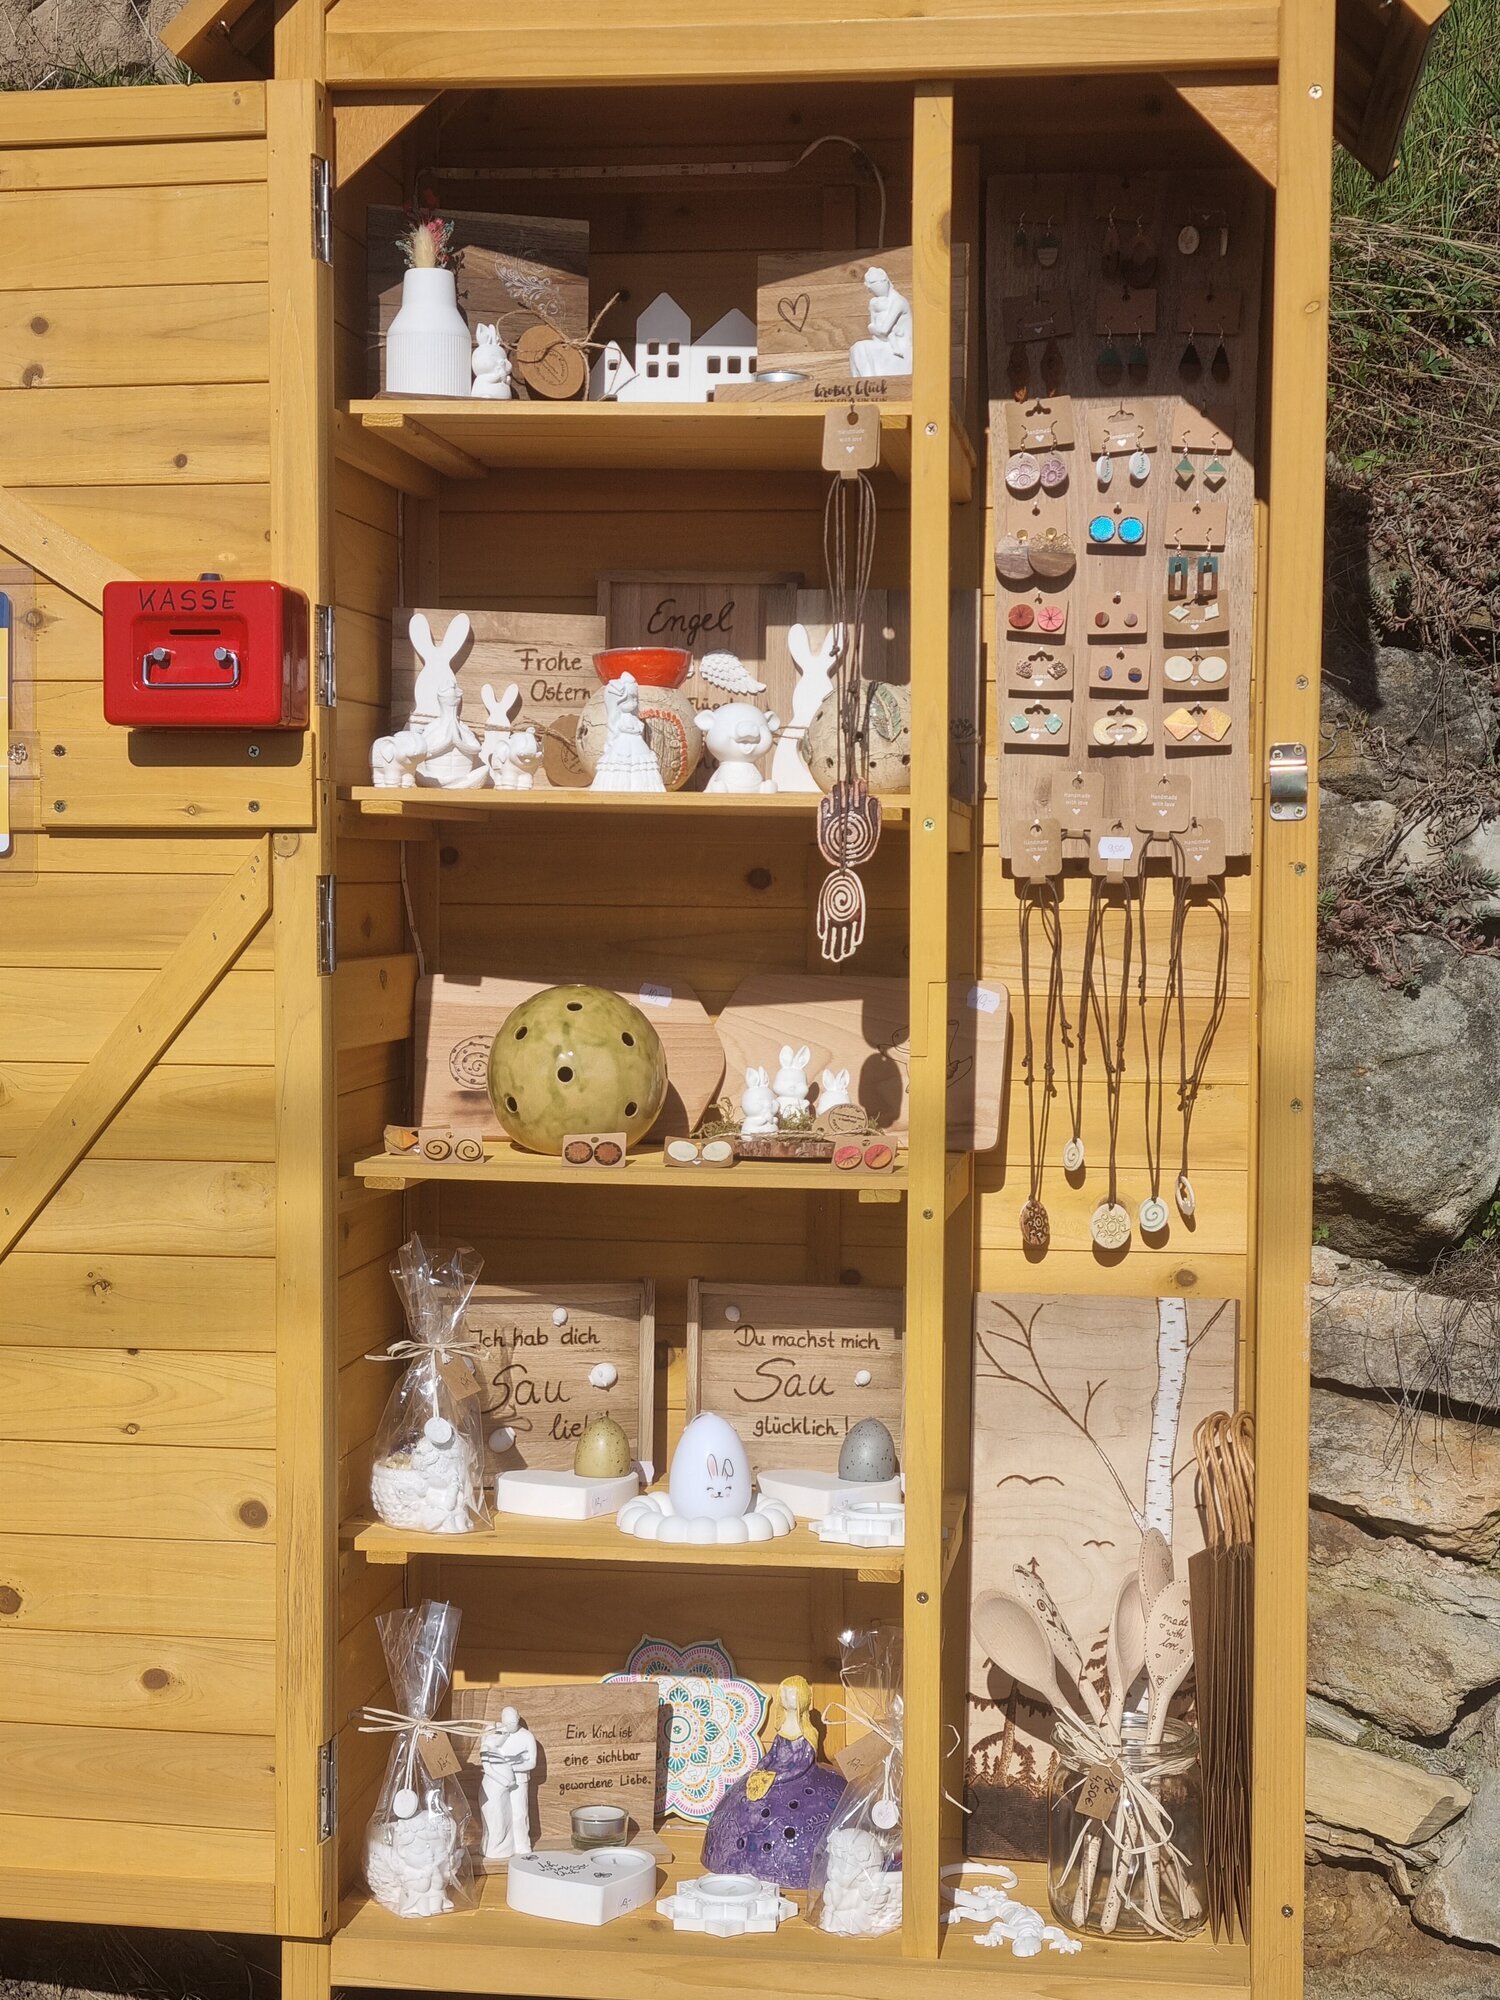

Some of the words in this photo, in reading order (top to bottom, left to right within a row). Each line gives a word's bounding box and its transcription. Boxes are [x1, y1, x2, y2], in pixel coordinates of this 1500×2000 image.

[139, 588, 236, 612] KASSE
[647, 598, 735, 645] Engel
[514, 648, 583, 672] Frohe
[530, 679, 591, 701] Ostern
[513, 1327, 549, 1346] hab
[560, 1326, 601, 1345] dich
[734, 1324, 766, 1347] Du
[772, 1330, 835, 1348] machst
[841, 1332, 881, 1350] mich
[481, 1363, 571, 1414] Sau
[734, 1357, 834, 1402] Sau
[753, 1415, 839, 1437] glücklich
[1161, 1613, 1189, 1627] made
[1159, 1637, 1180, 1651] love
[1166, 1627, 1186, 1640] with
[566, 1723, 587, 1740] Ein
[592, 1723, 616, 1739] Kind
[619, 1725, 632, 1738] ist
[563, 1753, 589, 1767] eine
[596, 1749, 642, 1764] sichtbar
[559, 1777, 614, 1796] gewordene
[620, 1773, 652, 1787] Liebe.
[1084, 1775, 1103, 1807] 4,50€
